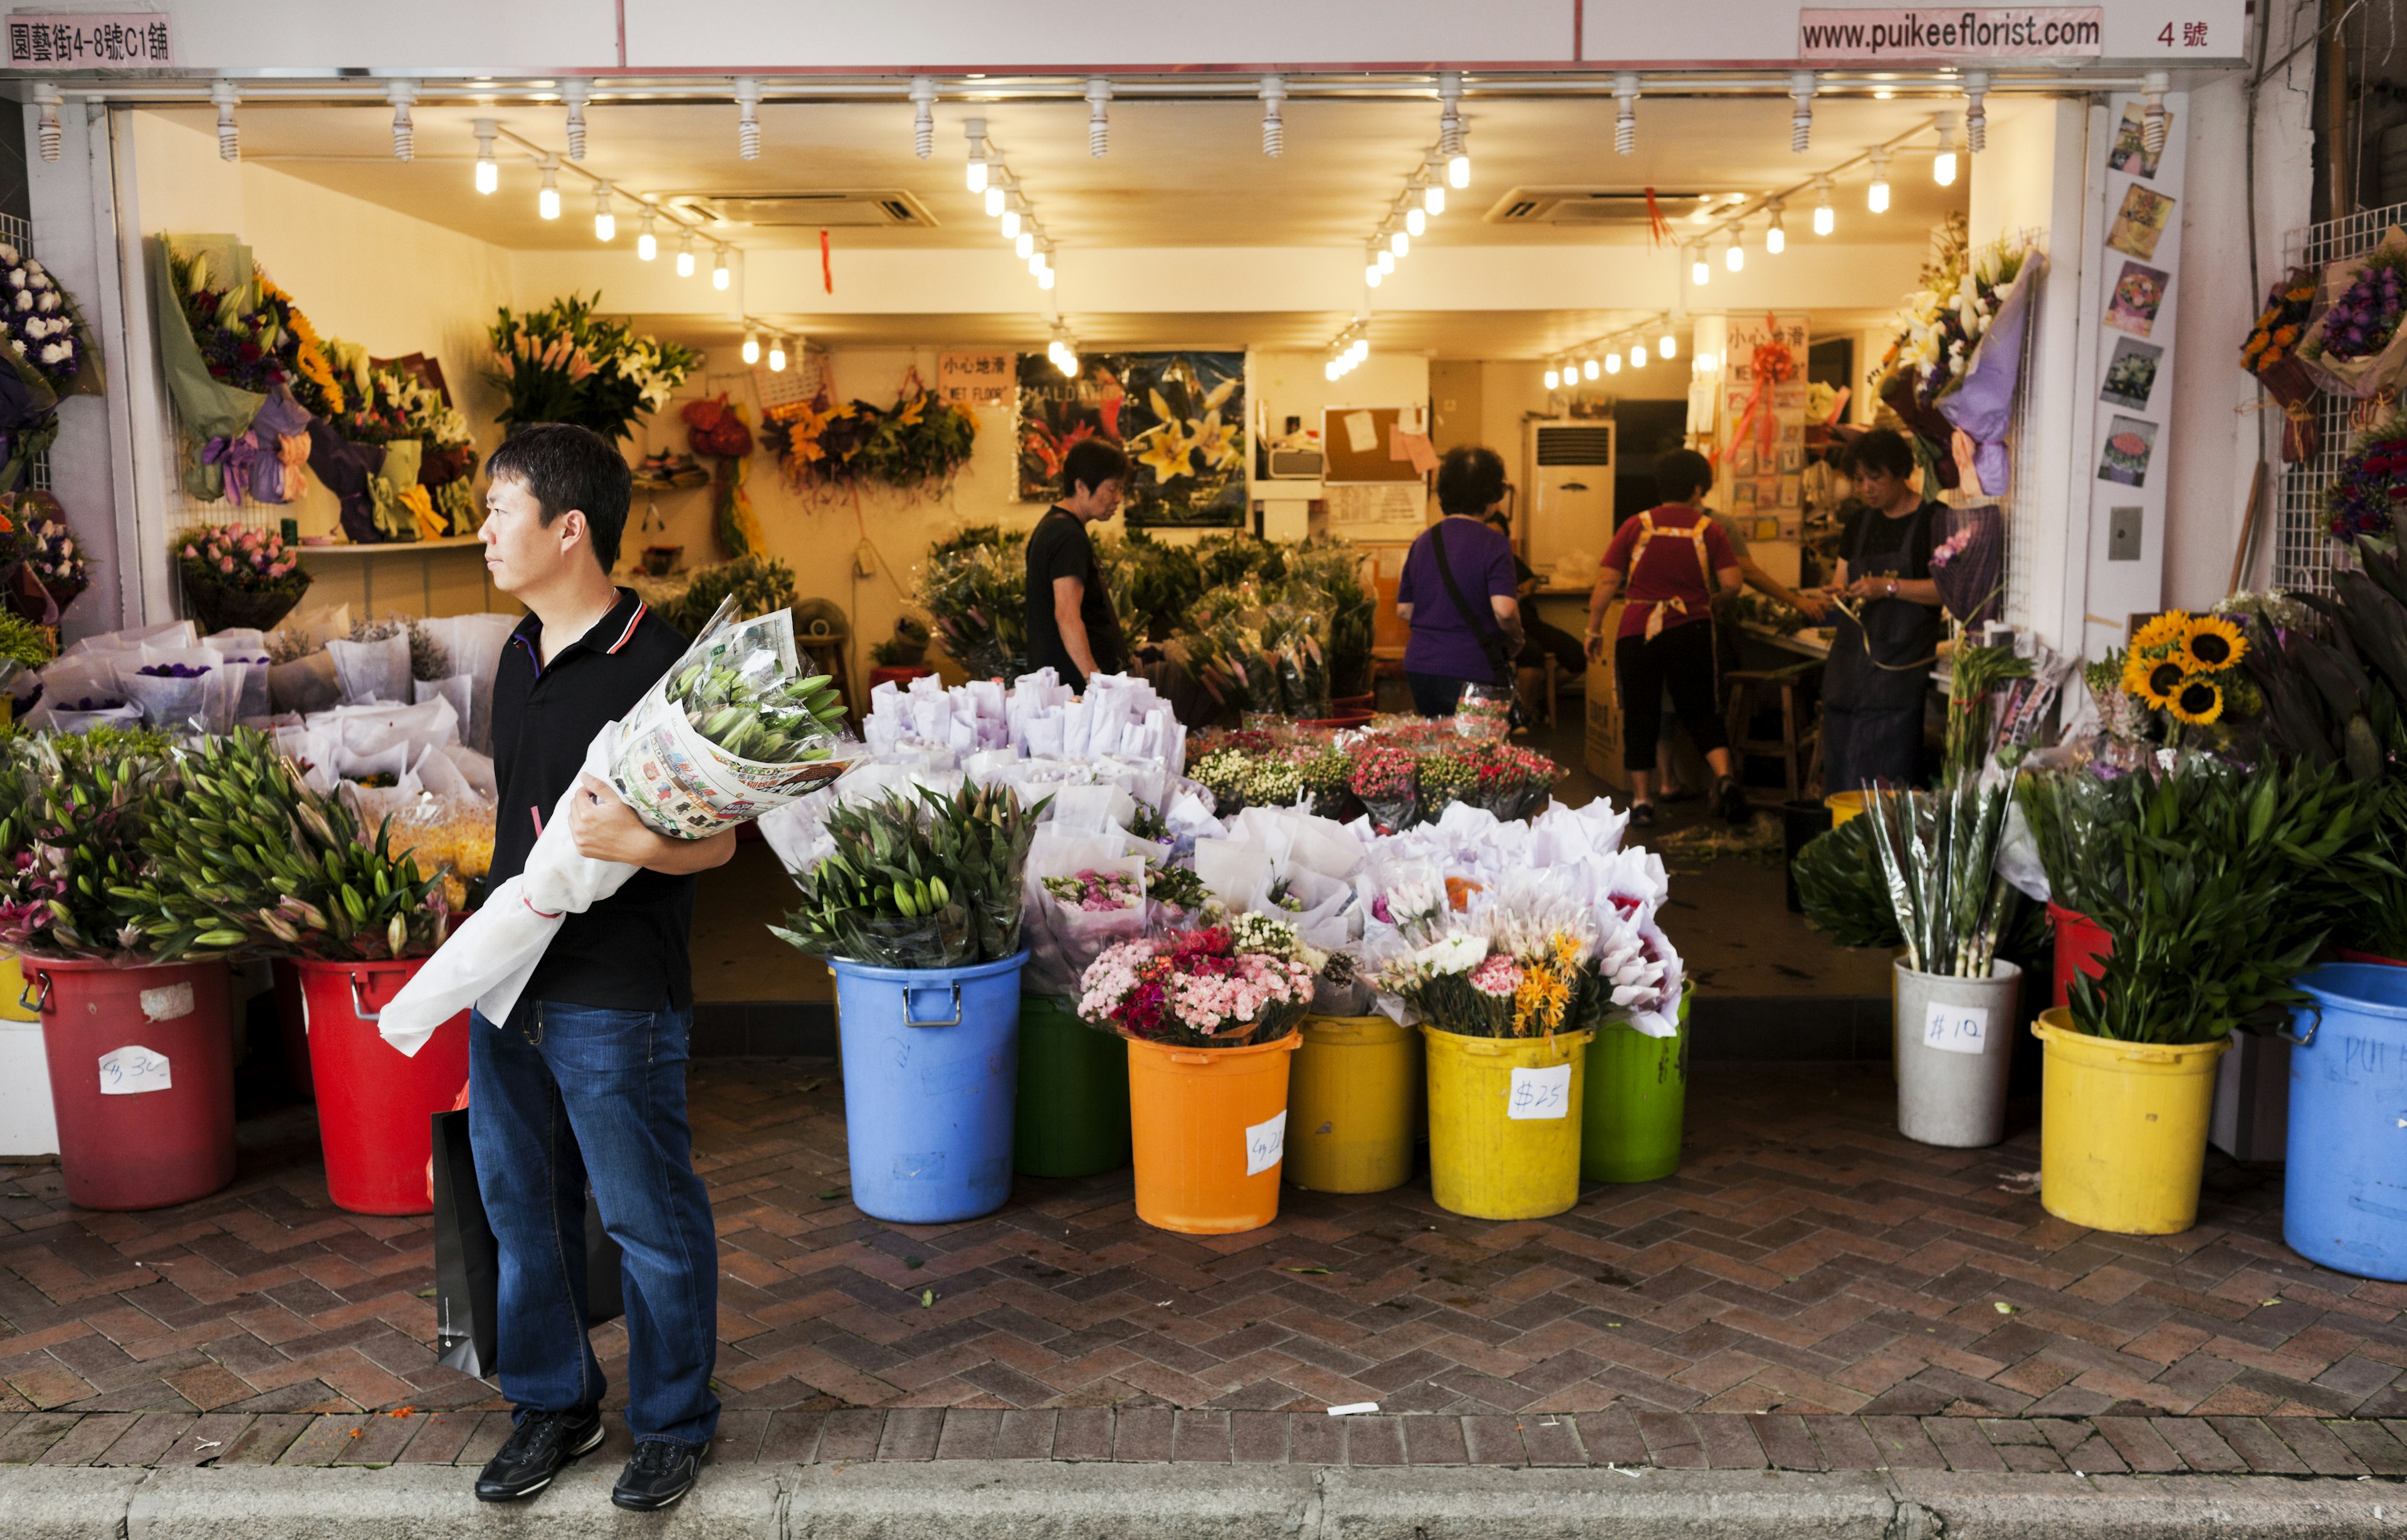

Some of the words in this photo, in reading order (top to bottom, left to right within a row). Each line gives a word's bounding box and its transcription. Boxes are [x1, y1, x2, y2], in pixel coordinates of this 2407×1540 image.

[1803, 13, 2099, 52] www.puikeeflorist.com
[943, 356, 1005, 374] 小心地滑
[1514, 1080, 1563, 1113] $25
